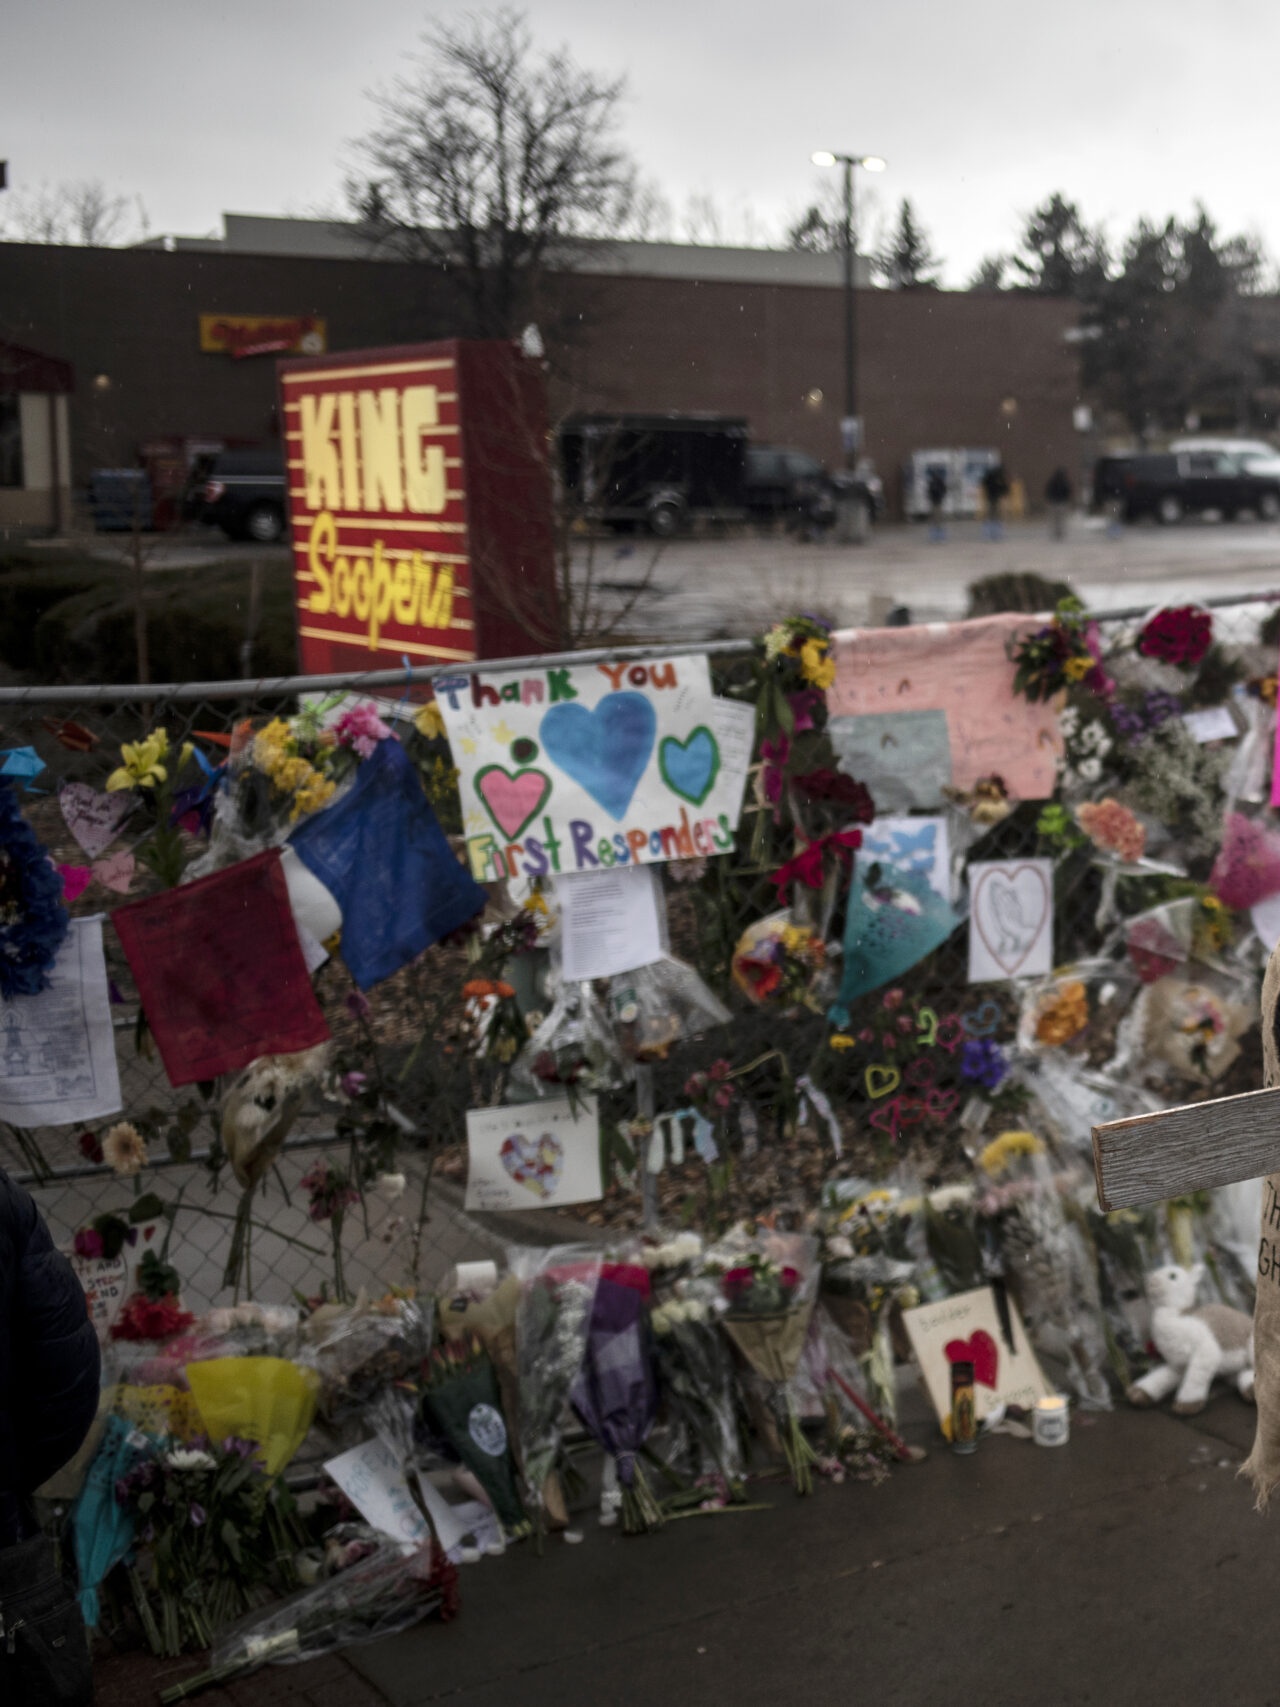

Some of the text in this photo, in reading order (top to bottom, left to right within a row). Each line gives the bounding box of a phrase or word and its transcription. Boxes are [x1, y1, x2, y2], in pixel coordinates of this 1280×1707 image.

[301, 385, 447, 514] KING
[308, 511, 454, 652] Soopers
[466, 805, 735, 884] First Responders
